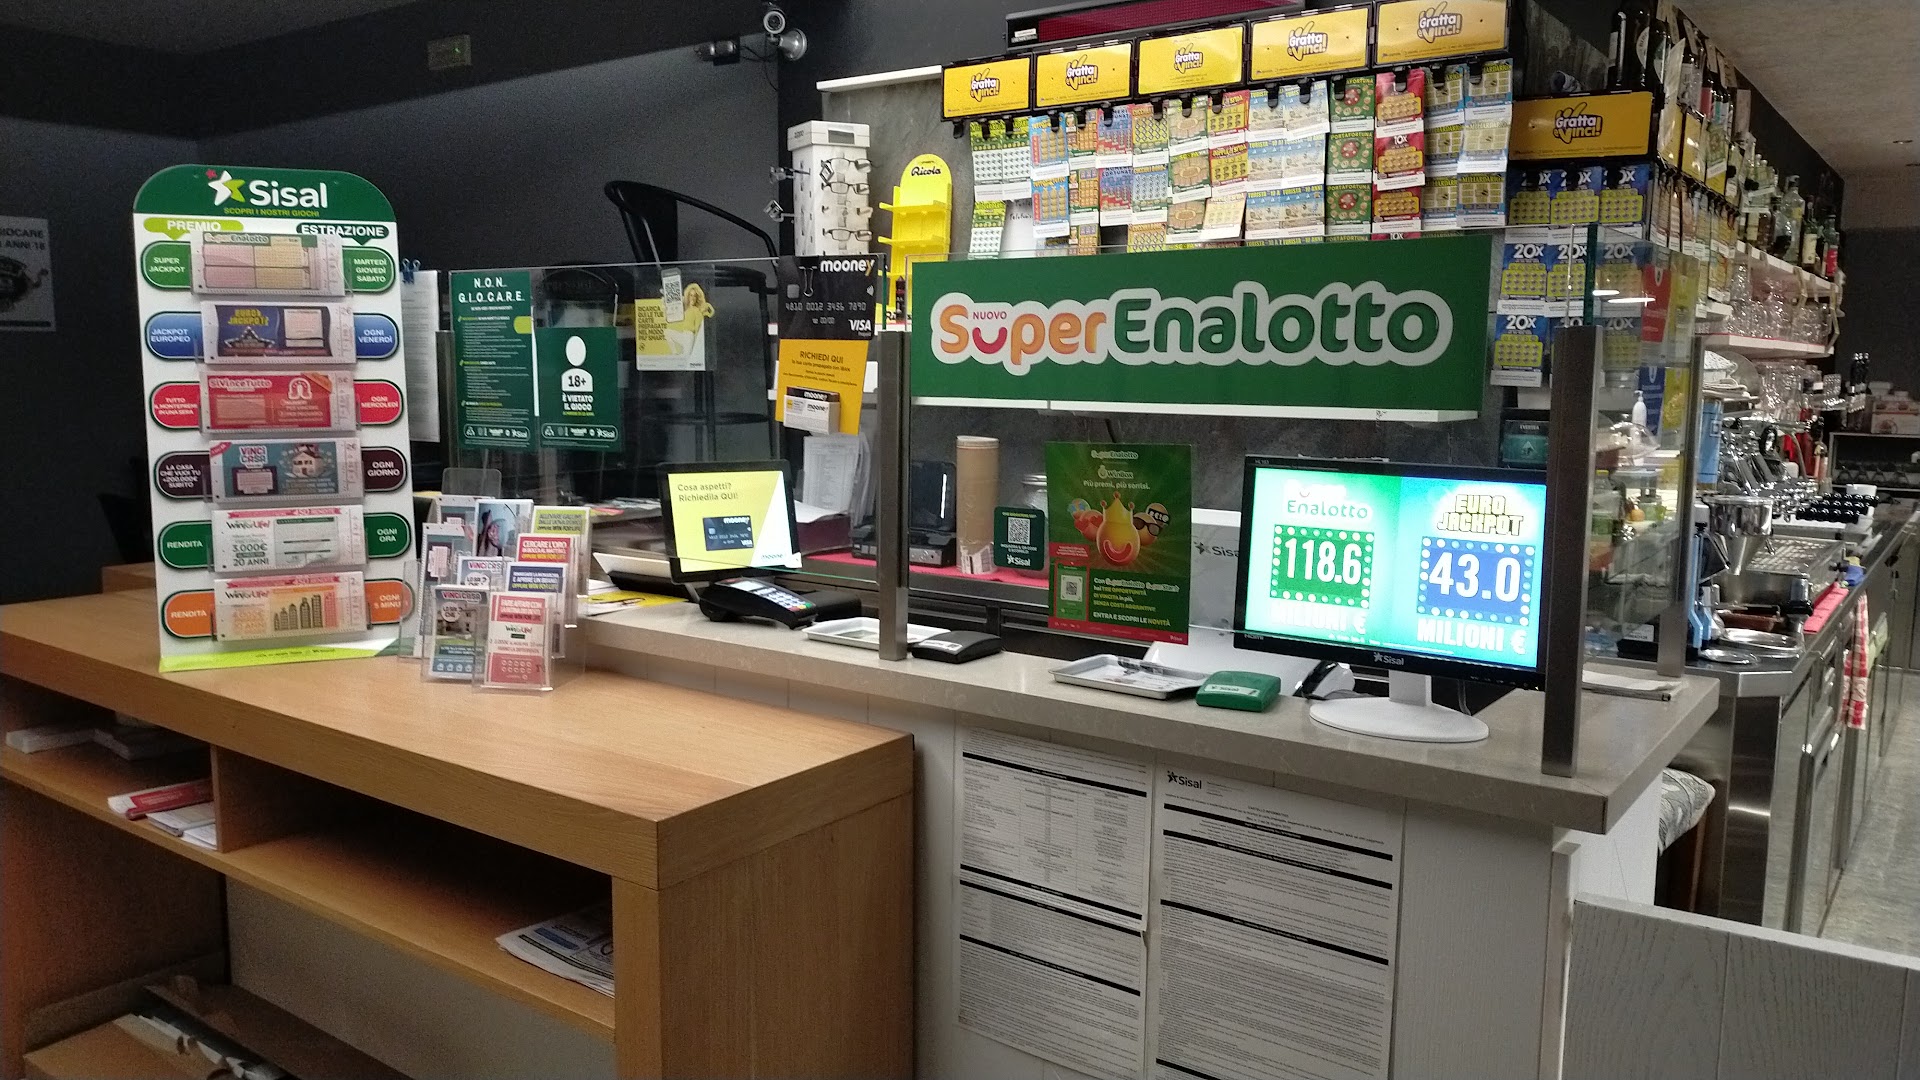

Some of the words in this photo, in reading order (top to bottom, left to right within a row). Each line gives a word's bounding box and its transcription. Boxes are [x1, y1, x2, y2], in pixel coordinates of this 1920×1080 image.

[1420, 14, 1457, 28] Gratta
[1289, 34, 1323, 47] Gratta
[1176, 53, 1199, 63] Gratta
[1067, 65, 1094, 77] Gratta
[971, 78, 996, 90] Gratta
[1556, 115, 1596, 128] Gratta
[911, 165, 942, 177] Ricola
[249, 179, 328, 208] Sisal
[167, 220, 221, 232] PREMIO
[301, 225, 385, 237] ESTRAZIONE
[1513, 243, 1544, 259] 20X
[1604, 243, 1634, 259] 20X
[353, 258, 387, 266] MARTEDÌ
[821, 259, 875, 277] mooney
[355, 266, 386, 274] GIOVEDÌ
[972, 310, 1007, 320] NUOVO
[848, 319, 872, 331] VISA
[1506, 315, 1536, 330] 20X
[358, 335, 393, 343] VENERDÌ
[800, 351, 829, 362] RICHIEDI
[831, 355, 844, 364] QUI
[568, 375, 587, 388] 18+
[566, 394, 593, 403] VIETATO
[570, 403, 592, 411] GIOCO
[241, 447, 266, 456] VINCI
[242, 455, 268, 463] CASA
[372, 461, 394, 469] OGNI
[367, 469, 400, 477] GIORNO
[678, 484, 698, 492] Cosa
[700, 482, 732, 492] aspetti?
[1083, 480, 1094, 488] Più
[678, 493, 719, 502] Richiedila
[1287, 500, 1368, 519] Enalotto
[1455, 494, 1506, 514] EURO
[1437, 512, 1524, 536] JACKPOT
[167, 541, 203, 549] RENDITA
[247, 557, 270, 565] ANNI
[1014, 556, 1031, 567] Sisal
[1284, 537, 1362, 585] 118.6
[1428, 552, 1521, 602] 43.0
[170, 610, 207, 618] RENDITA
[1417, 618, 1504, 651] MILIONI
[1510, 629, 1529, 655] €
[1383, 655, 1404, 666] Sisal
[1178, 776, 1202, 790] Sisal
